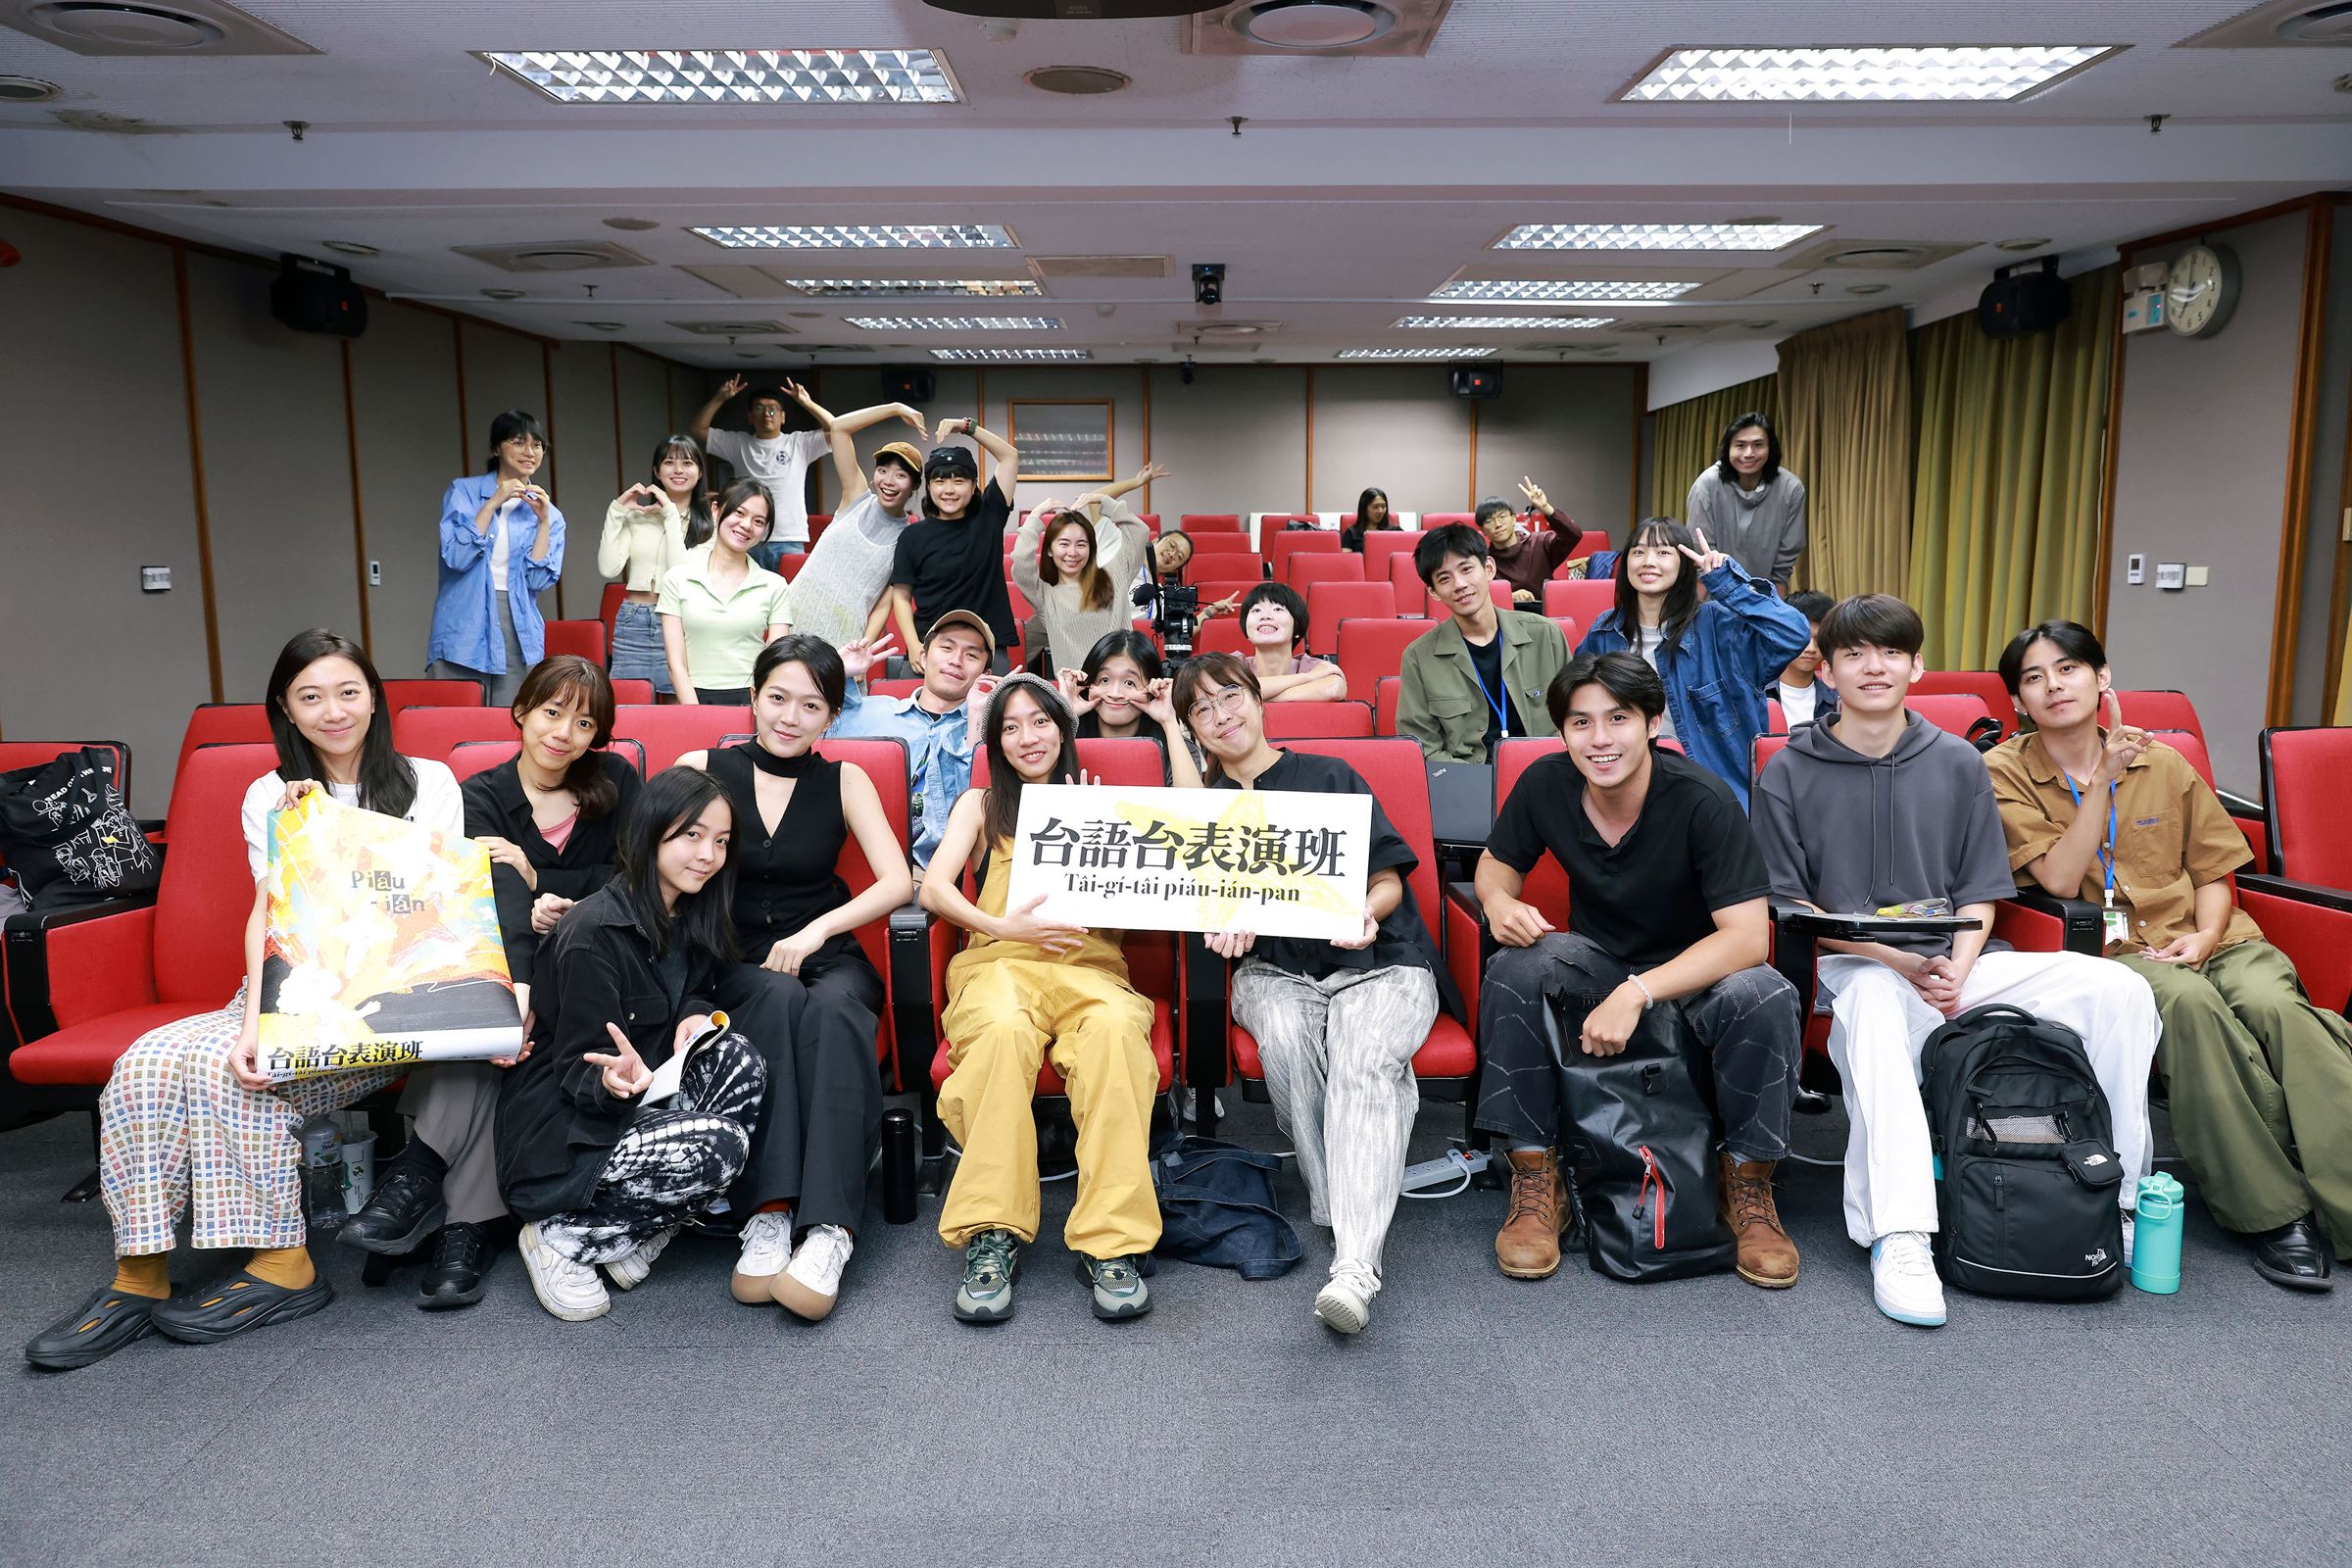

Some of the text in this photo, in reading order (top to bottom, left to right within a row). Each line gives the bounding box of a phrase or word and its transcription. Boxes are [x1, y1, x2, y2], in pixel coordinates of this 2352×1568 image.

[1030, 817, 1347, 876] 台語台表演班
[351, 870, 405, 891] Piáu
[1065, 873, 1299, 905] Tâi-gí-tâi piáu-ián-pan
[268, 1040, 423, 1070] 台語台表演班
